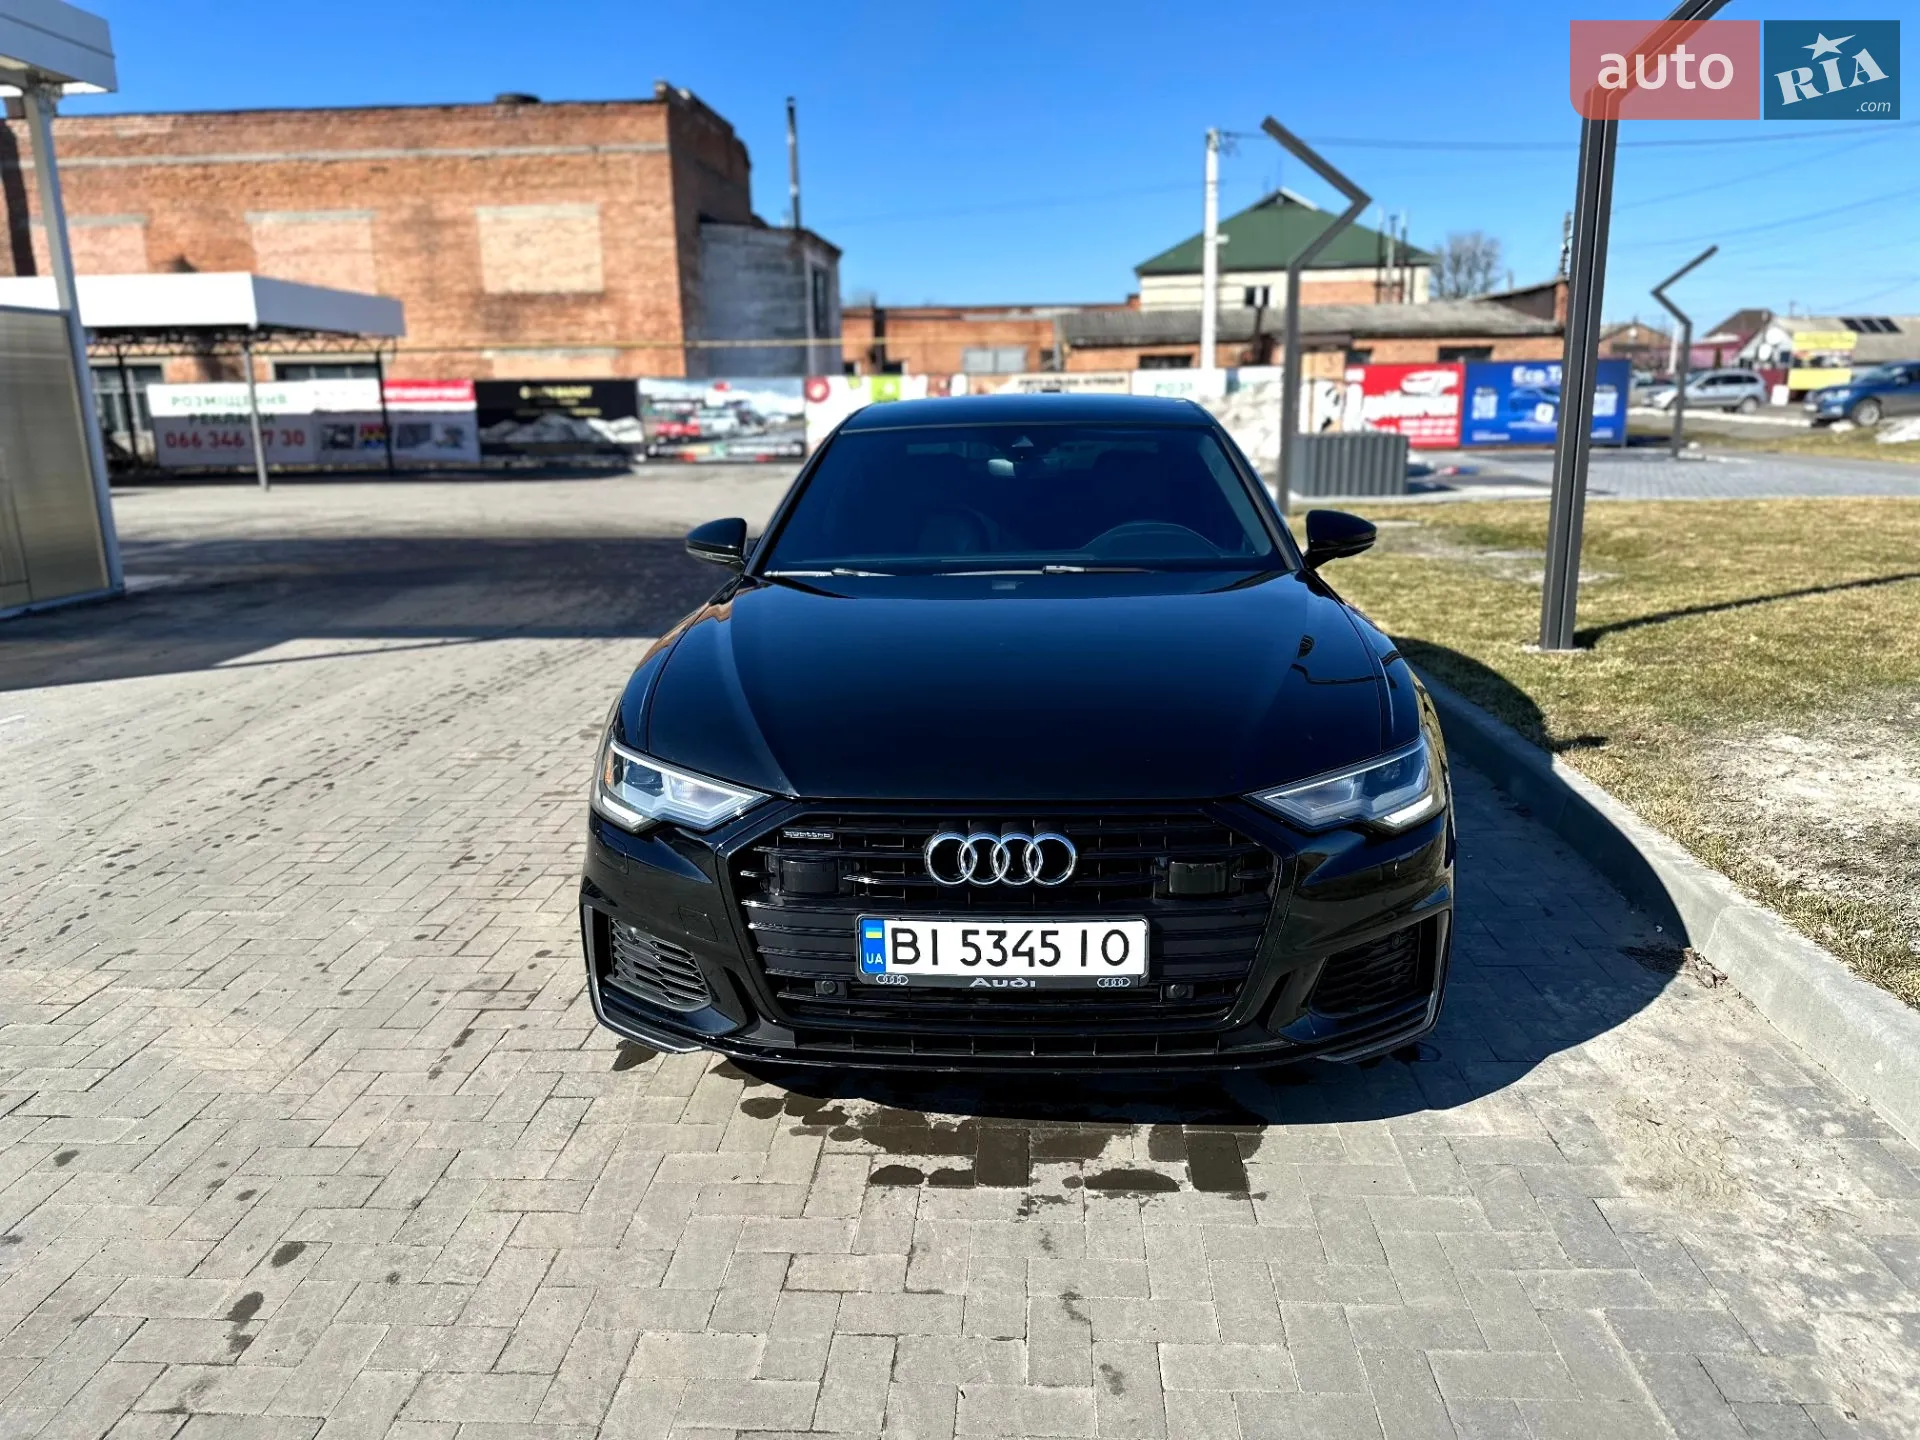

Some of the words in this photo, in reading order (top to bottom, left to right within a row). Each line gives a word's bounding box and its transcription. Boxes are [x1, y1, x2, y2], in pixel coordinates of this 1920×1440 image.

[188, 413, 275, 425] РЕКЛАИ
[165, 430, 202, 448] 066
[249, 429, 274, 446] 7
[891, 927, 938, 965] BI
[960, 929, 1061, 967] 5345
[866, 952, 884, 965] UA
[969, 977, 1036, 988] Audi
